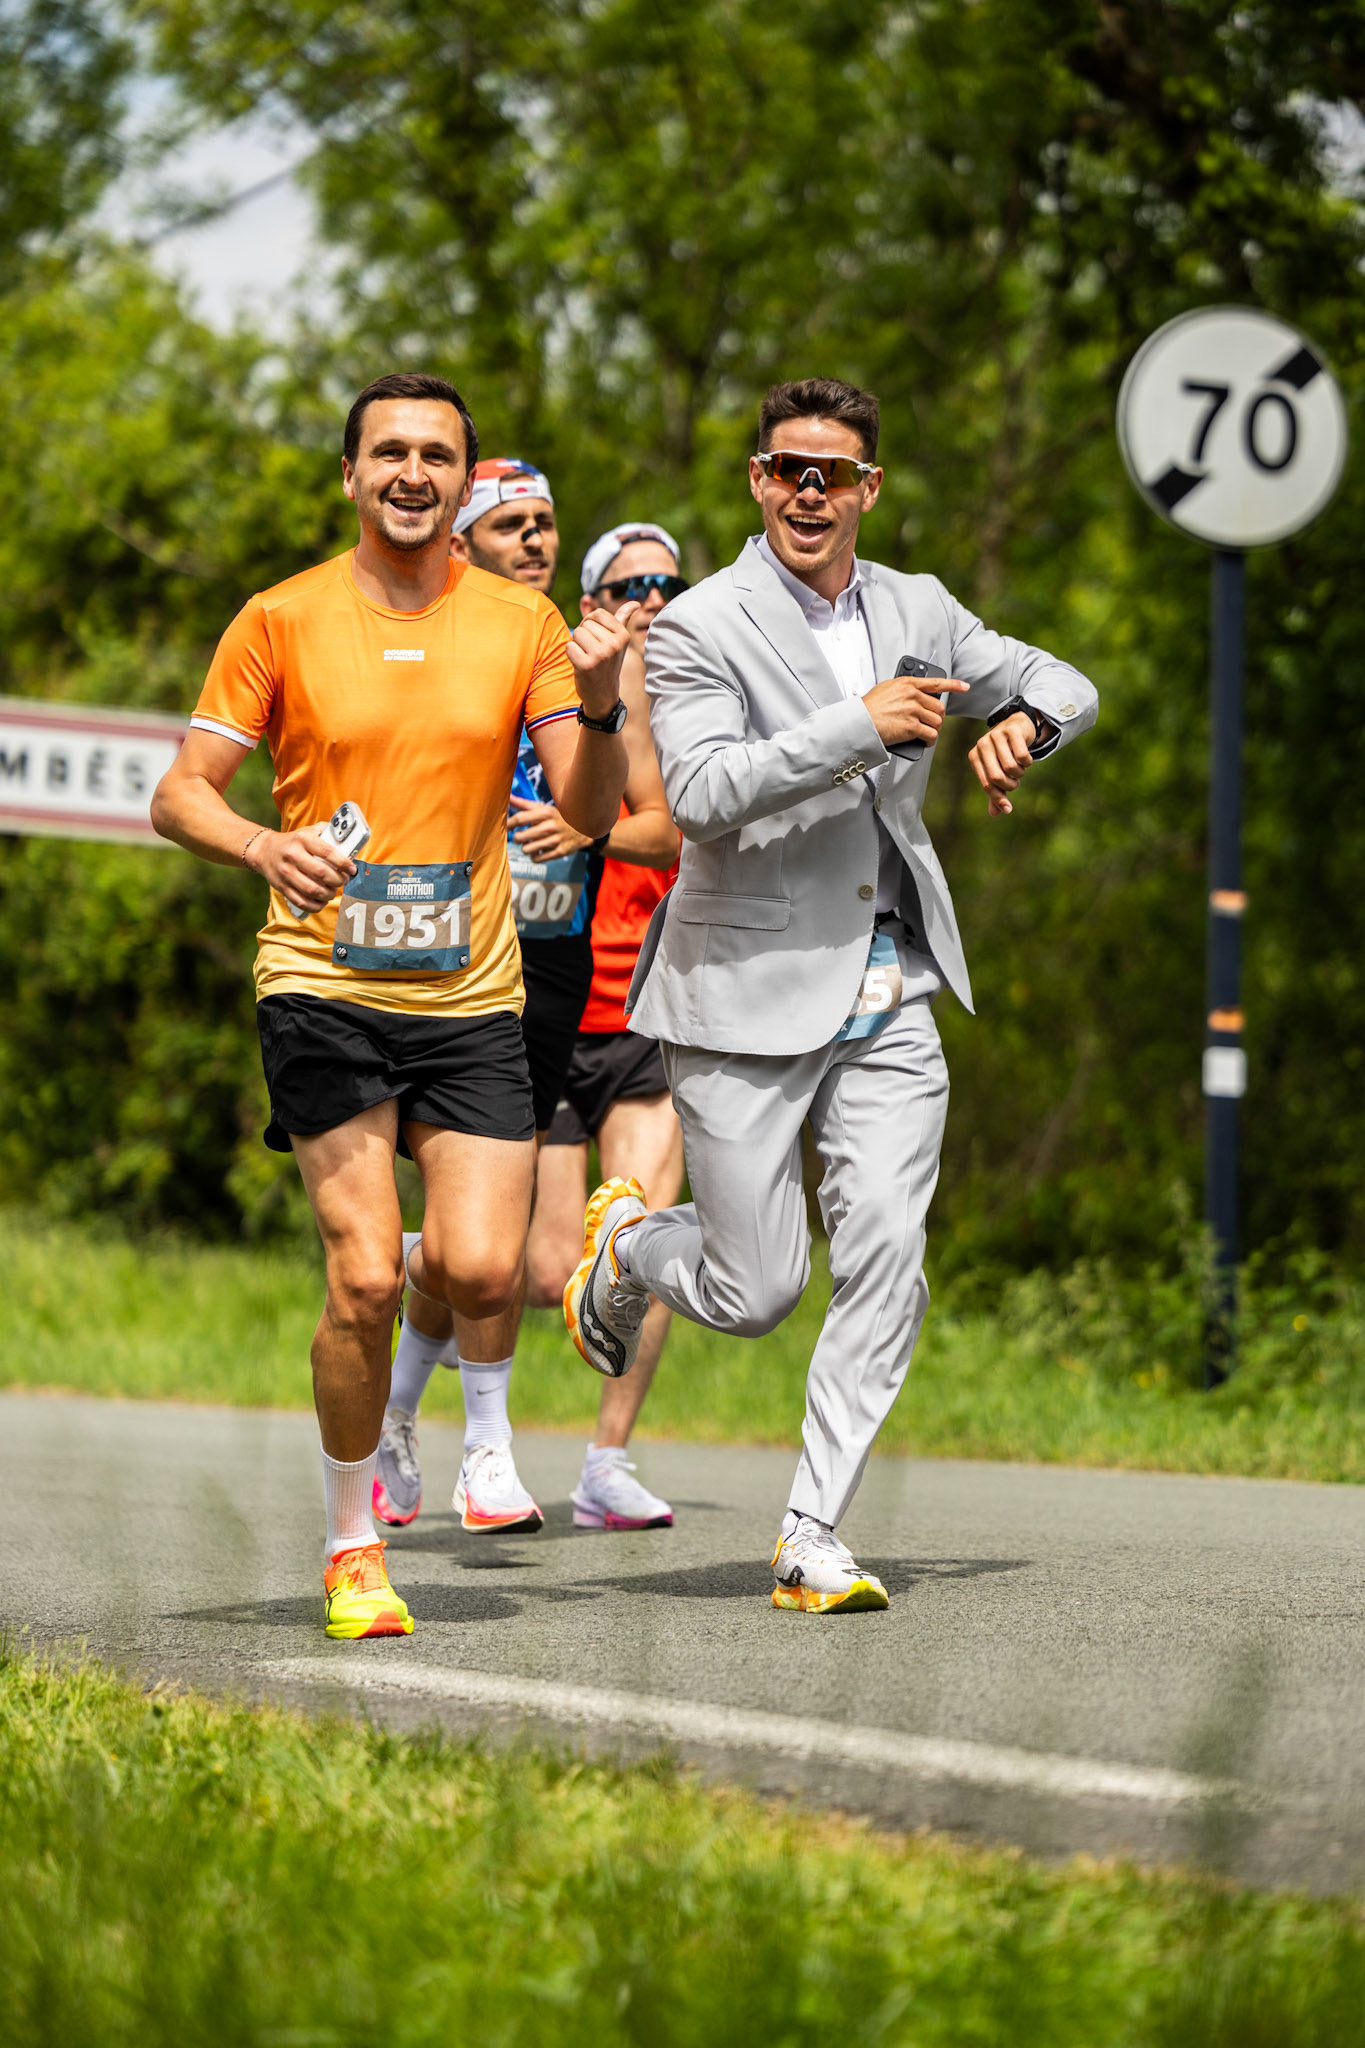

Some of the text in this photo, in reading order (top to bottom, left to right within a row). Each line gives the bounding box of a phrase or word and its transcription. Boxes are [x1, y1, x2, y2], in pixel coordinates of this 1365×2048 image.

[1179, 376, 1298, 476] 70
[387, 883, 434, 895] MARATHON
[345, 902, 460, 948] 1951
[852, 969, 893, 1013] 5
